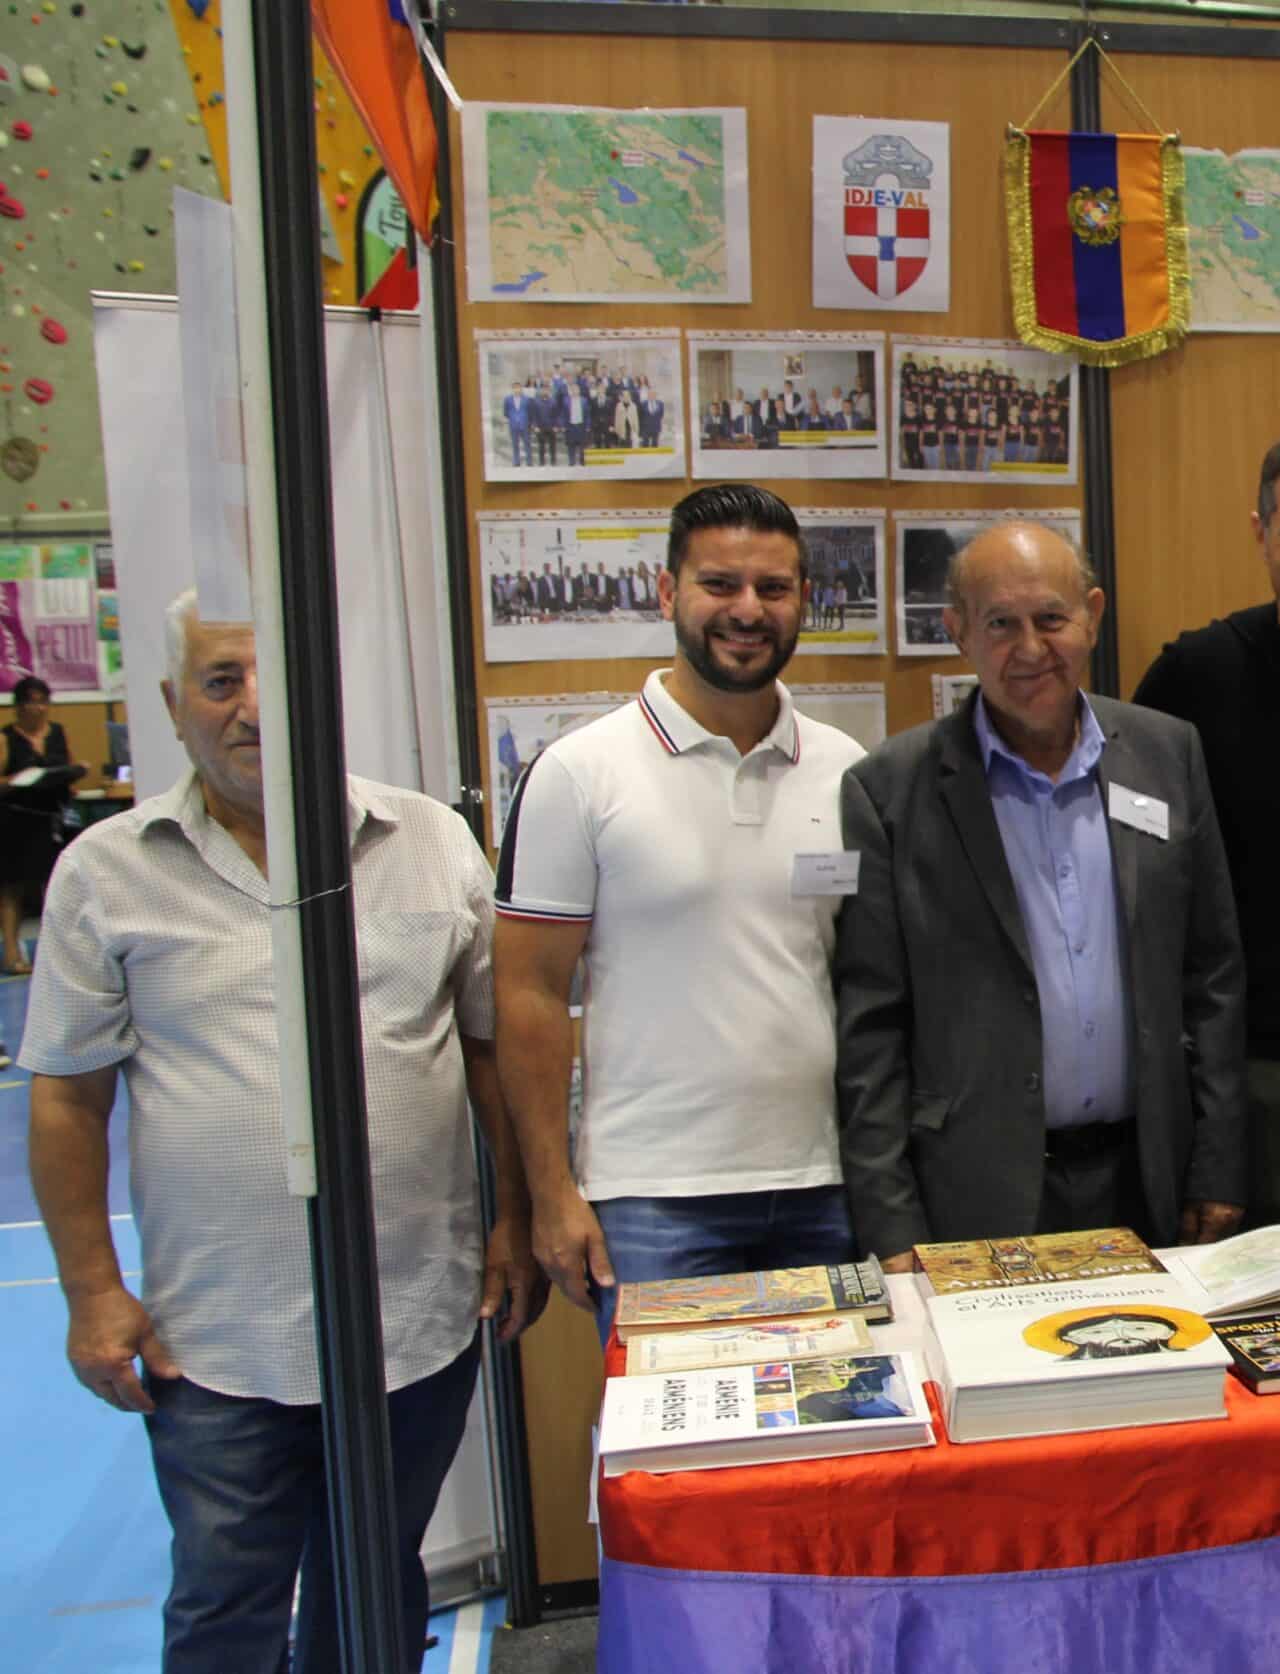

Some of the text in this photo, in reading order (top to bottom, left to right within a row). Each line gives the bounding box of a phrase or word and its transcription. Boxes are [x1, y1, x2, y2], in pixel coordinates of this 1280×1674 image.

[845, 188, 928, 208] IDJE-VAL
[1079, 1262, 1151, 1277] sacra
[661, 1379, 693, 1432] ARMÉNIENS
[715, 1379, 746, 1420] ARMÉNIE
